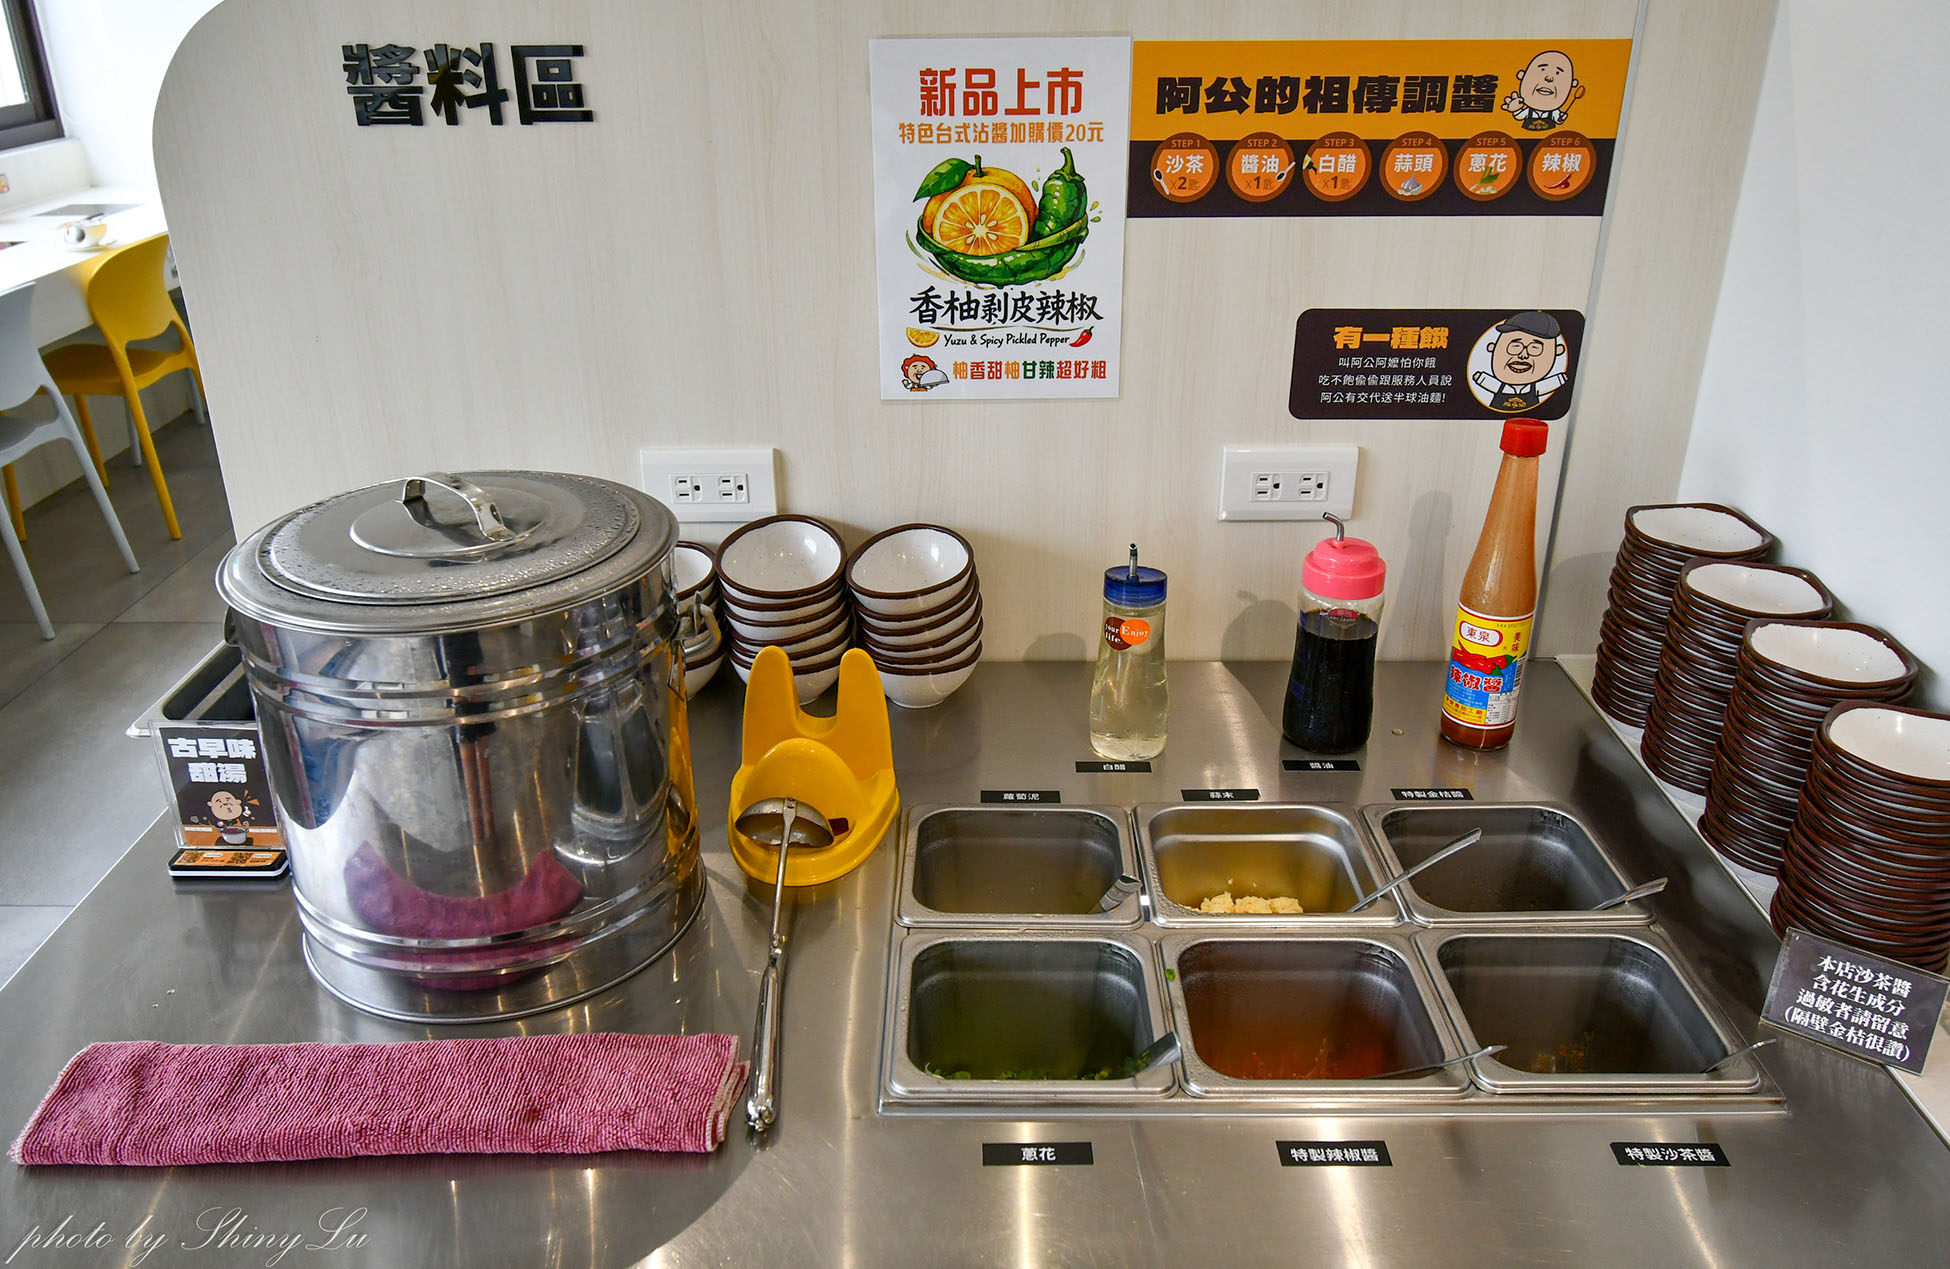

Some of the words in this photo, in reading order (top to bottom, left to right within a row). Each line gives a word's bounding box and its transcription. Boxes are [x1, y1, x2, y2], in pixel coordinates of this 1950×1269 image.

[341, 42, 594, 126] 醬料區
[919, 67, 1084, 117] 新品上市
[1156, 74, 1499, 115] 阿公的祖傳調醬
[899, 121, 1104, 144] 特色台式沾醬加購價20元
[1402, 137, 1423, 146] STEP
[1476, 137, 1497, 146] STEP
[1551, 137, 1572, 146] STEP
[1171, 139, 1192, 148] STEP
[1247, 138, 1268, 147] STEP
[1325, 138, 1346, 147] STEP
[1165, 154, 1205, 174] 沙茶
[1240, 154, 1280, 174] 醬油
[1318, 154, 1357, 173] 白醋
[1394, 153, 1434, 172] 蒜頭
[1542, 153, 1582, 172] 辣椒
[909, 285, 1105, 326] 香柚剝皮辣椒
[943, 333, 968, 348] Yuzu
[970, 335, 978, 345] &
[980, 333, 1004, 348] Spicy
[1006, 331, 1037, 346] Pickled
[1039, 332, 1070, 347] Pepper
[1333, 326, 1449, 350] 有一種餓
[952, 360, 1107, 381] 柚香甜柚甘辣超好粗
[1318, 374, 1453, 387] 吃不飽偷偷跟服務人員說
[1104, 623, 1120, 634] your
[1121, 625, 1149, 637] Enjoy
[1466, 626, 1491, 643] 東泉
[1449, 664, 1504, 693] 辣椒醬
[167, 737, 257, 759] 古早味
[1816, 955, 1912, 999] 本店沙茶醬
[1812, 973, 1906, 1017] 含花生成分
[1796, 988, 1910, 1041] 過敏者請留意
[1290, 1147, 1380, 1163] 特製辣椒醬
[1625, 1147, 1717, 1162] 特製沙茶醬
